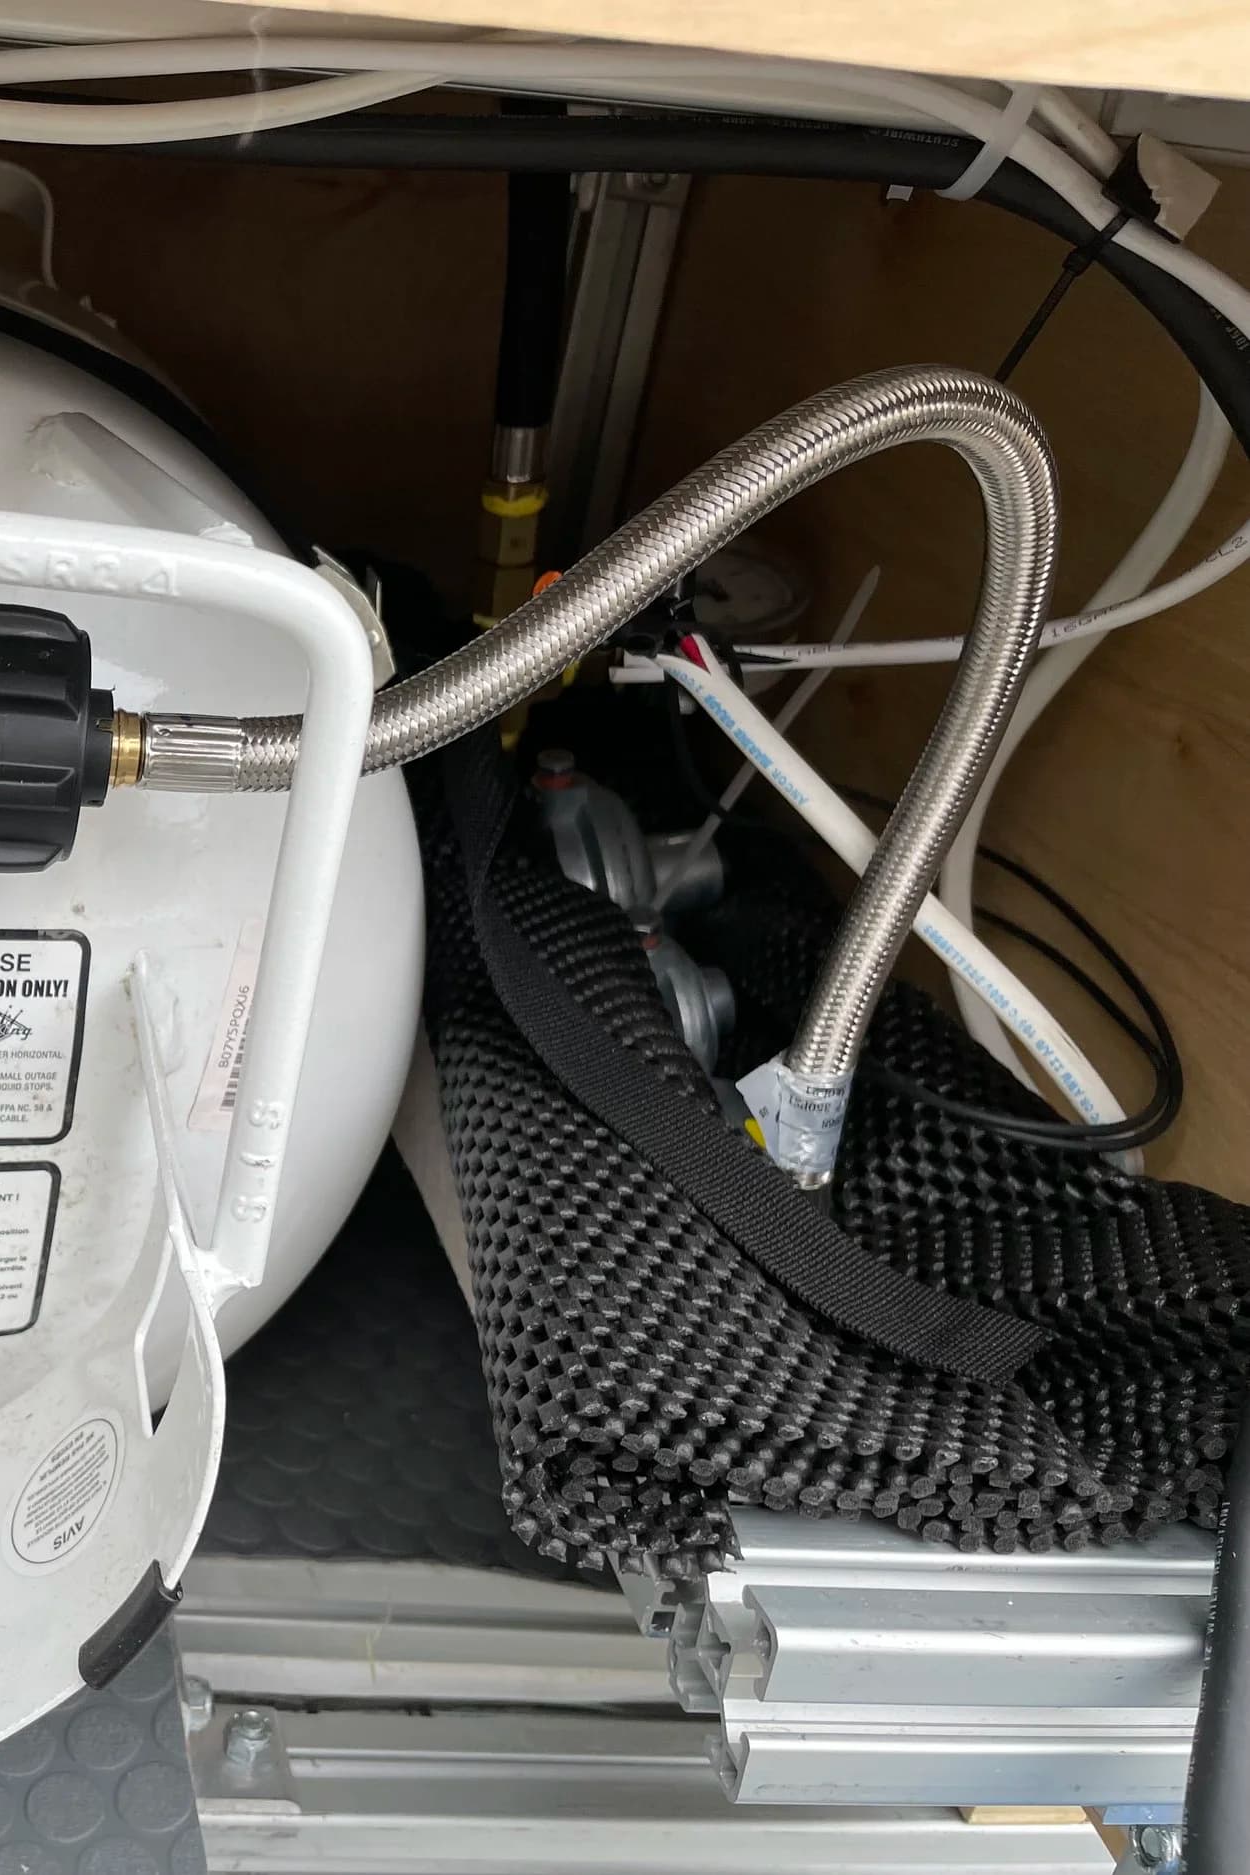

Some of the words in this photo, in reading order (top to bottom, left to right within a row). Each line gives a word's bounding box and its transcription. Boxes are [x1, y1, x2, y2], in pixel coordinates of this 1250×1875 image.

[22, 979, 68, 998] ONLY!
[219, 985, 250, 1069] B07Y5PQXJ6
[25, 1072, 57, 1080] OUTAGE
[53, 1516, 85, 1550] AVIS
